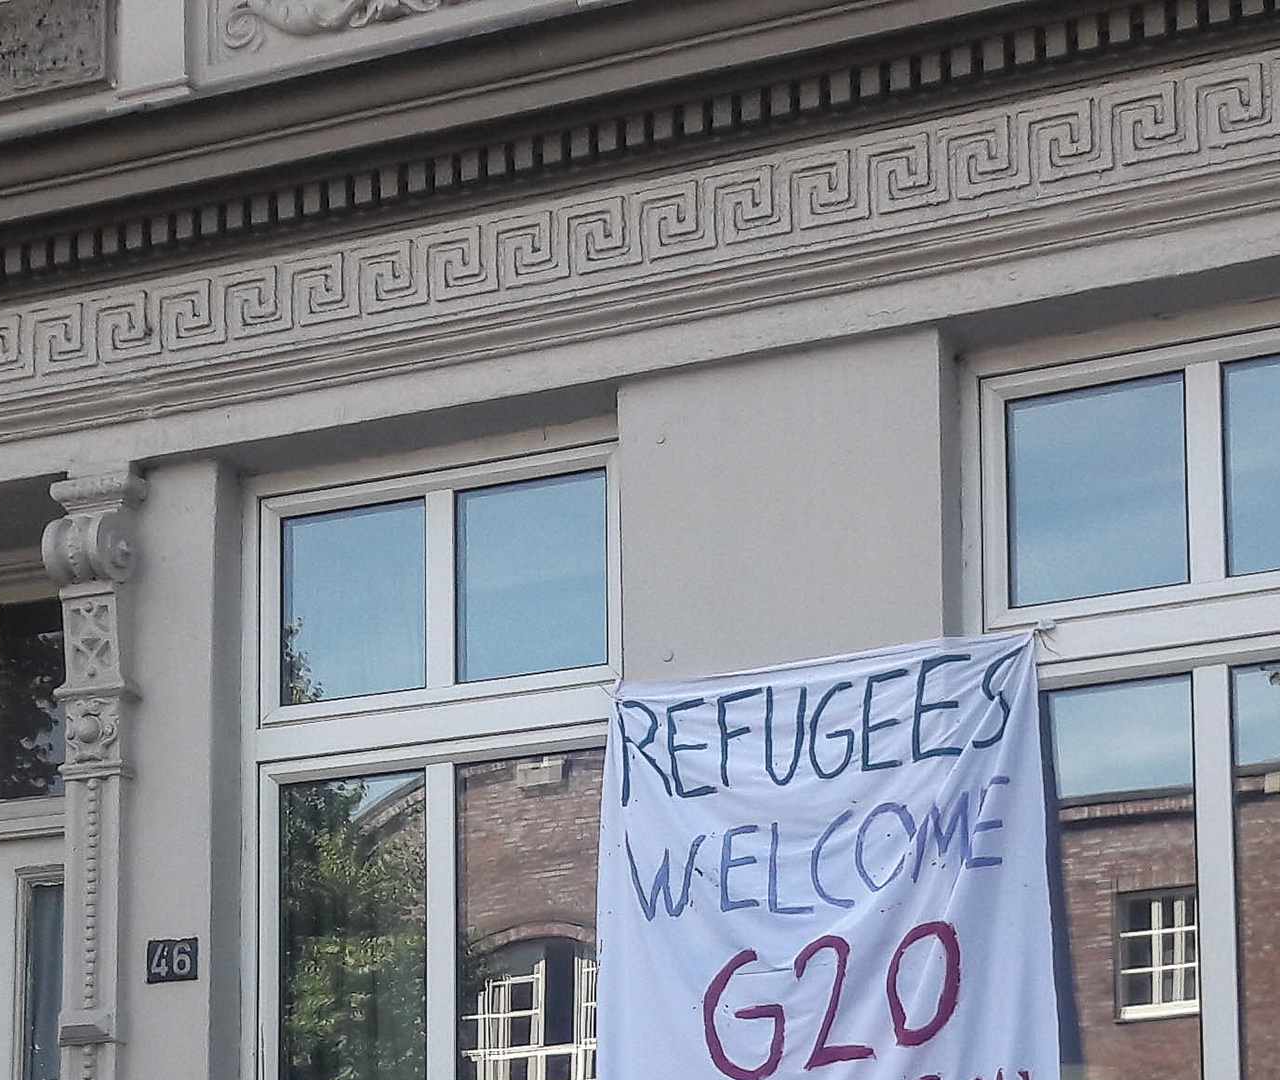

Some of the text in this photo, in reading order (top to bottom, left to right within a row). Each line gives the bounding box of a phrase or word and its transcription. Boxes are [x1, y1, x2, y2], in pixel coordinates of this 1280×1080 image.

[616, 652, 1023, 807] REFUGEES
[624, 776, 1010, 921] WELCOME
[150, 942, 192, 977] 46
